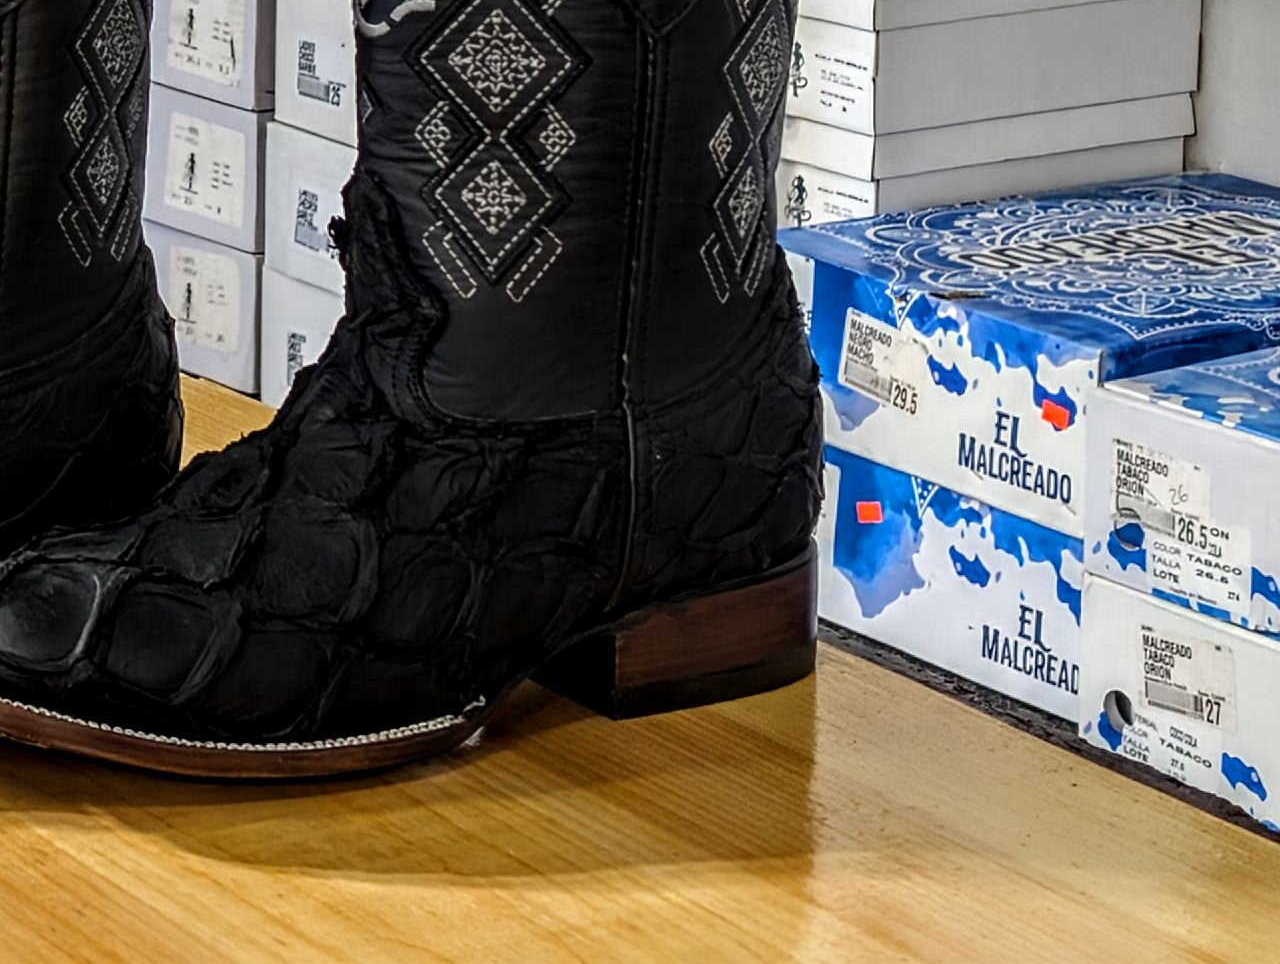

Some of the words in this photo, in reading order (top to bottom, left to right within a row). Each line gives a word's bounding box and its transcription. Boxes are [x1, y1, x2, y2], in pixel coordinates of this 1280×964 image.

[850, 318, 893, 348] MALCREADO
[847, 343, 874, 365] MACHO
[892, 384, 918, 415] 29.5
[994, 410, 1027, 458] EL
[958, 432, 1072, 504] MALCREADO
[1116, 448, 1169, 477] MALCREADO
[1116, 462, 1150, 484] TABACO
[1115, 476, 1145, 496] ORION
[1168, 484, 1189, 506] 26
[1178, 517, 1207, 550] 26.5
[1152, 554, 1182, 570] TALLA
[1153, 541, 1181, 555] COLOR
[1187, 553, 1242, 576] TABACO
[1153, 568, 1180, 584] LOTE
[1018, 604, 1052, 653] EL
[981, 624, 1080, 696] MALCREAD
[1142, 634, 1193, 659] MALCREADO
[1143, 648, 1175, 668] TABACO
[1144, 662, 1172, 680] ORION
[1205, 699, 1221, 726] 27
[1123, 745, 1149, 762] LOTE
[1159, 737, 1212, 769] TABACO
